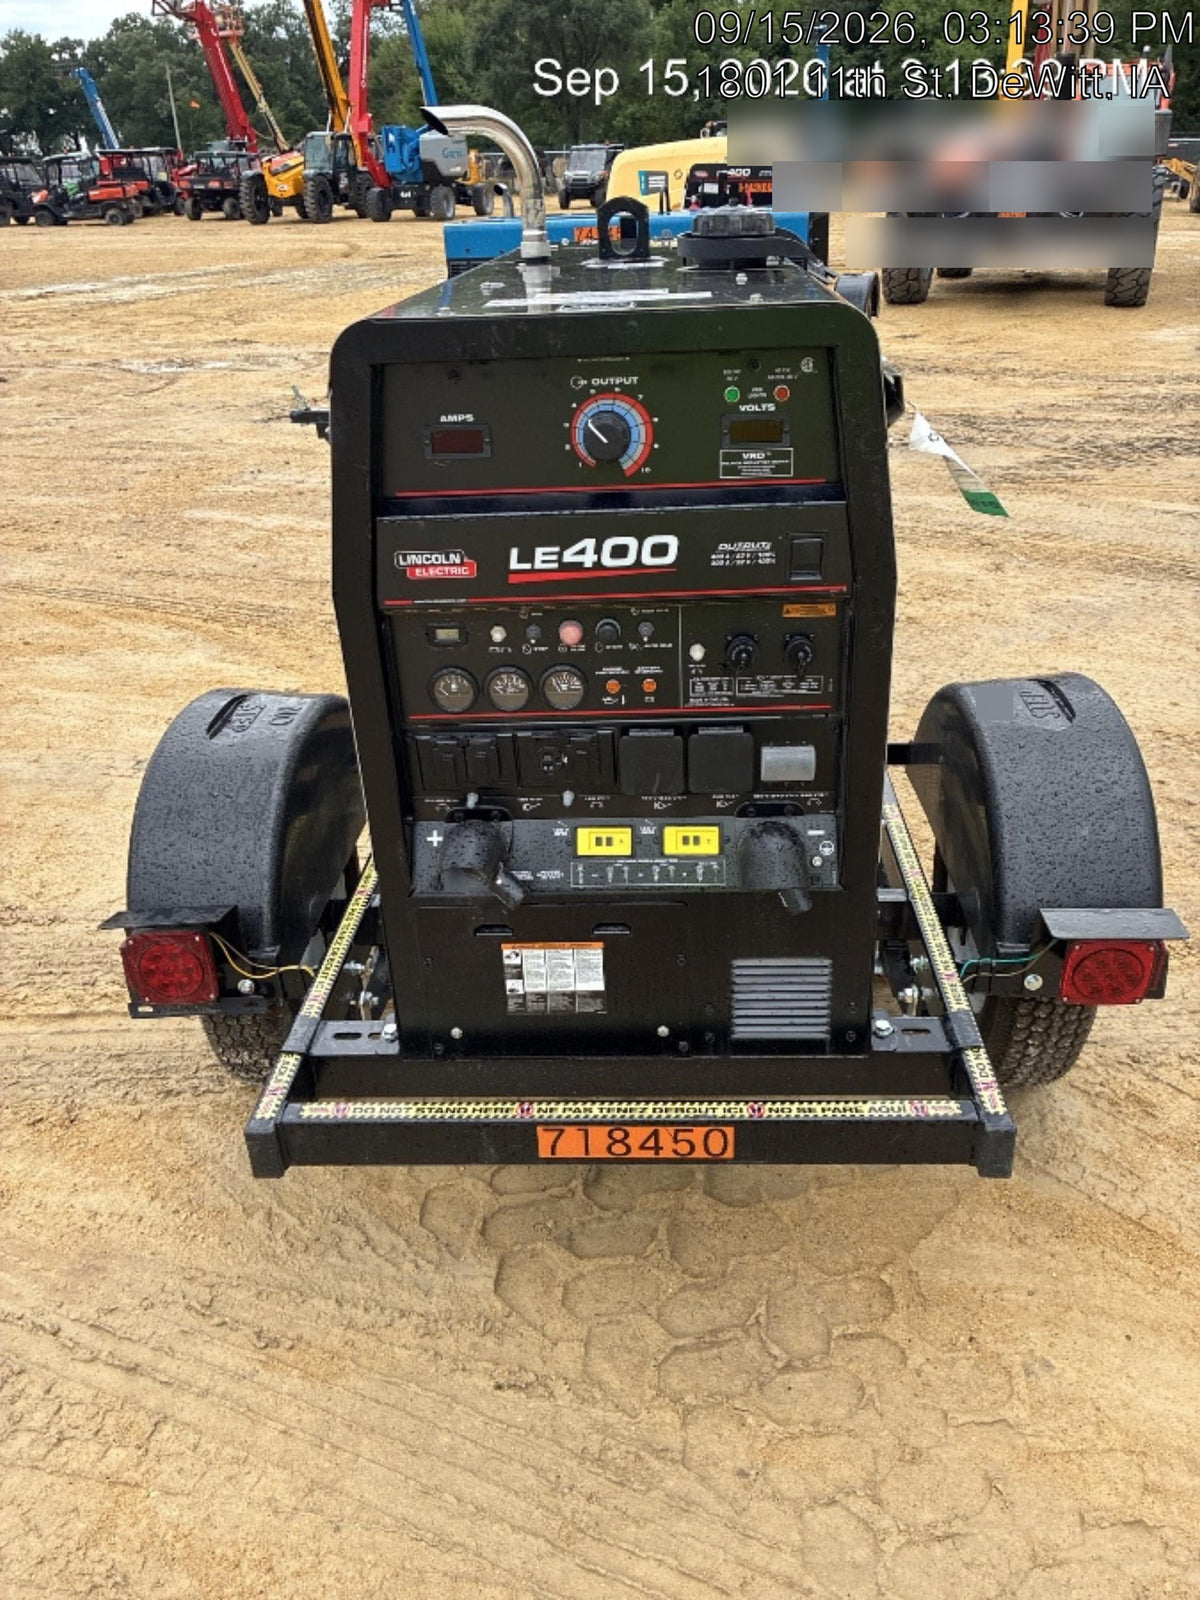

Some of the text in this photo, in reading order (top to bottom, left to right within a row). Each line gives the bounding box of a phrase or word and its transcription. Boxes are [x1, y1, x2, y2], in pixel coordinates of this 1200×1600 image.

[591, 377, 638, 385] OUTPUT
[739, 403, 776, 411] VOLTS
[440, 414, 475, 422] AMPS
[509, 535, 679, 570] LE400
[398, 553, 462, 565] LINCOLN
[415, 566, 470, 577] ELECTRIC
[352, 1105, 516, 1114] DO NOT STAND HERE
[536, 1105, 744, 1114] NE PAS TENEZ DEBOUT ICI
[767, 1105, 792, 1114] NO
[797, 1105, 817, 1114] SE
[821, 1105, 865, 1114] PARE
[542, 1127, 728, 1157] 718450
